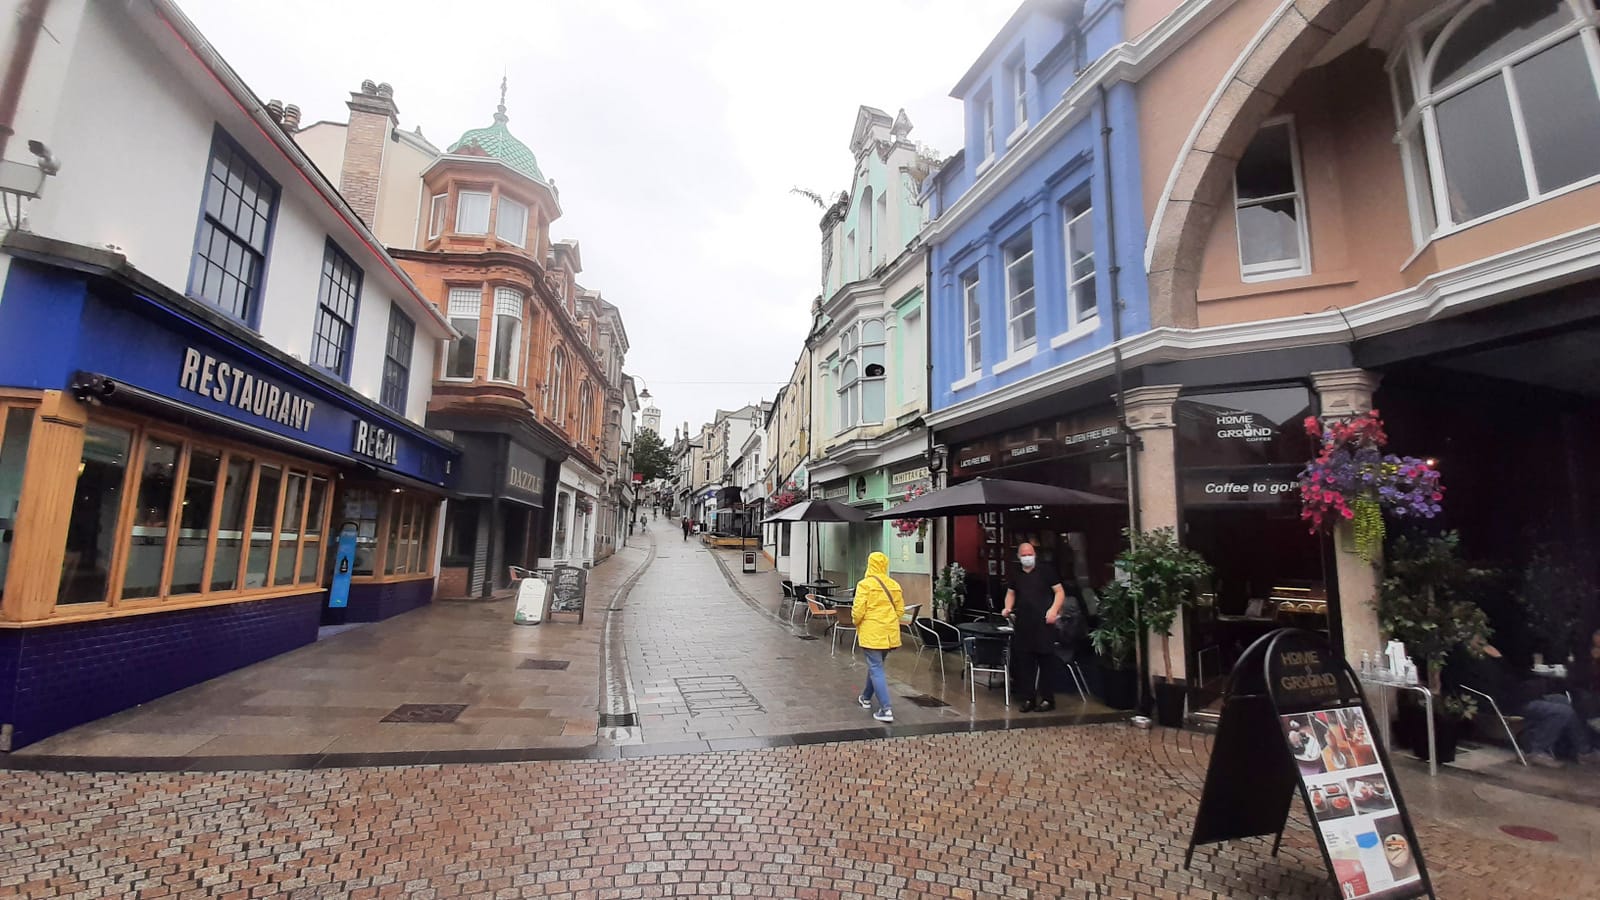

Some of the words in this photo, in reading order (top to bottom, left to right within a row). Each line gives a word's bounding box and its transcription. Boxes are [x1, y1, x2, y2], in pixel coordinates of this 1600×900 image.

[180, 347, 315, 432] RESTAURANT
[1216, 415, 1253, 425] HOME
[1064, 433, 1086, 445] GLUTEN
[1086, 429, 1102, 441] FREE
[1102, 426, 1118, 437] MENU
[1217, 427, 1271, 438] GROUND
[355, 419, 398, 465] REGAL
[1011, 447, 1025, 457] VEGAN
[1026, 444, 1039, 453] MENU
[510, 466, 542, 494] DAZZLE
[1205, 483, 1249, 493] Coffee
[1252, 483, 1266, 492] to
[1269, 482, 1293, 495] go!
[1281, 651, 1321, 665] HOME
[1281, 673, 1337, 690] GROUND
